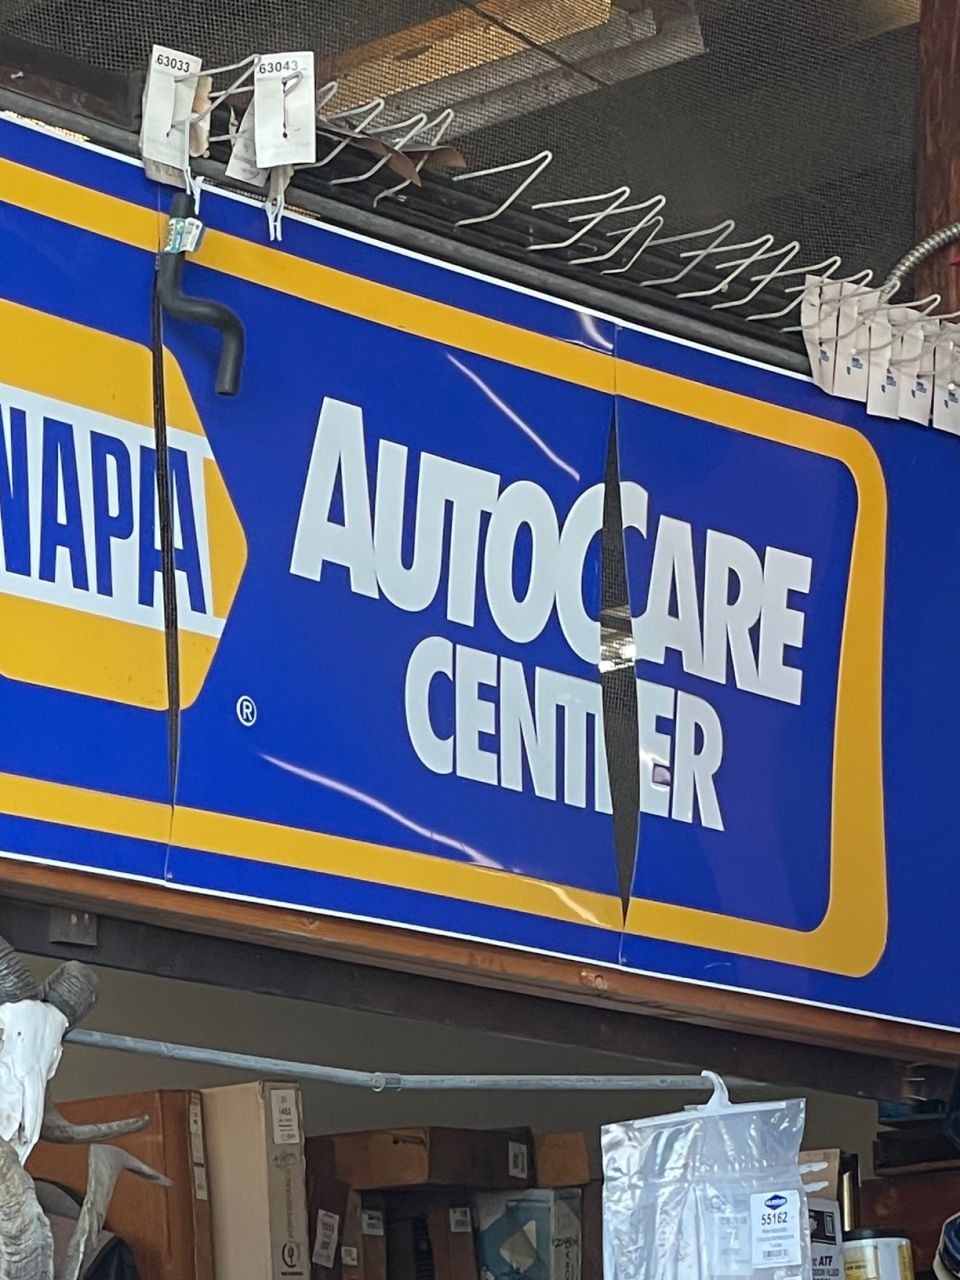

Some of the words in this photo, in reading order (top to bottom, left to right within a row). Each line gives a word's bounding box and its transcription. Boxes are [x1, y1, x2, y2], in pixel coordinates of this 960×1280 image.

[156, 54, 190, 73] 63033
[259, 59, 299, 74] 63043
[404, 636, 724, 832] CENTER
[761, 1212, 788, 1226] 55162
[818, 1255, 833, 1267] ATF
